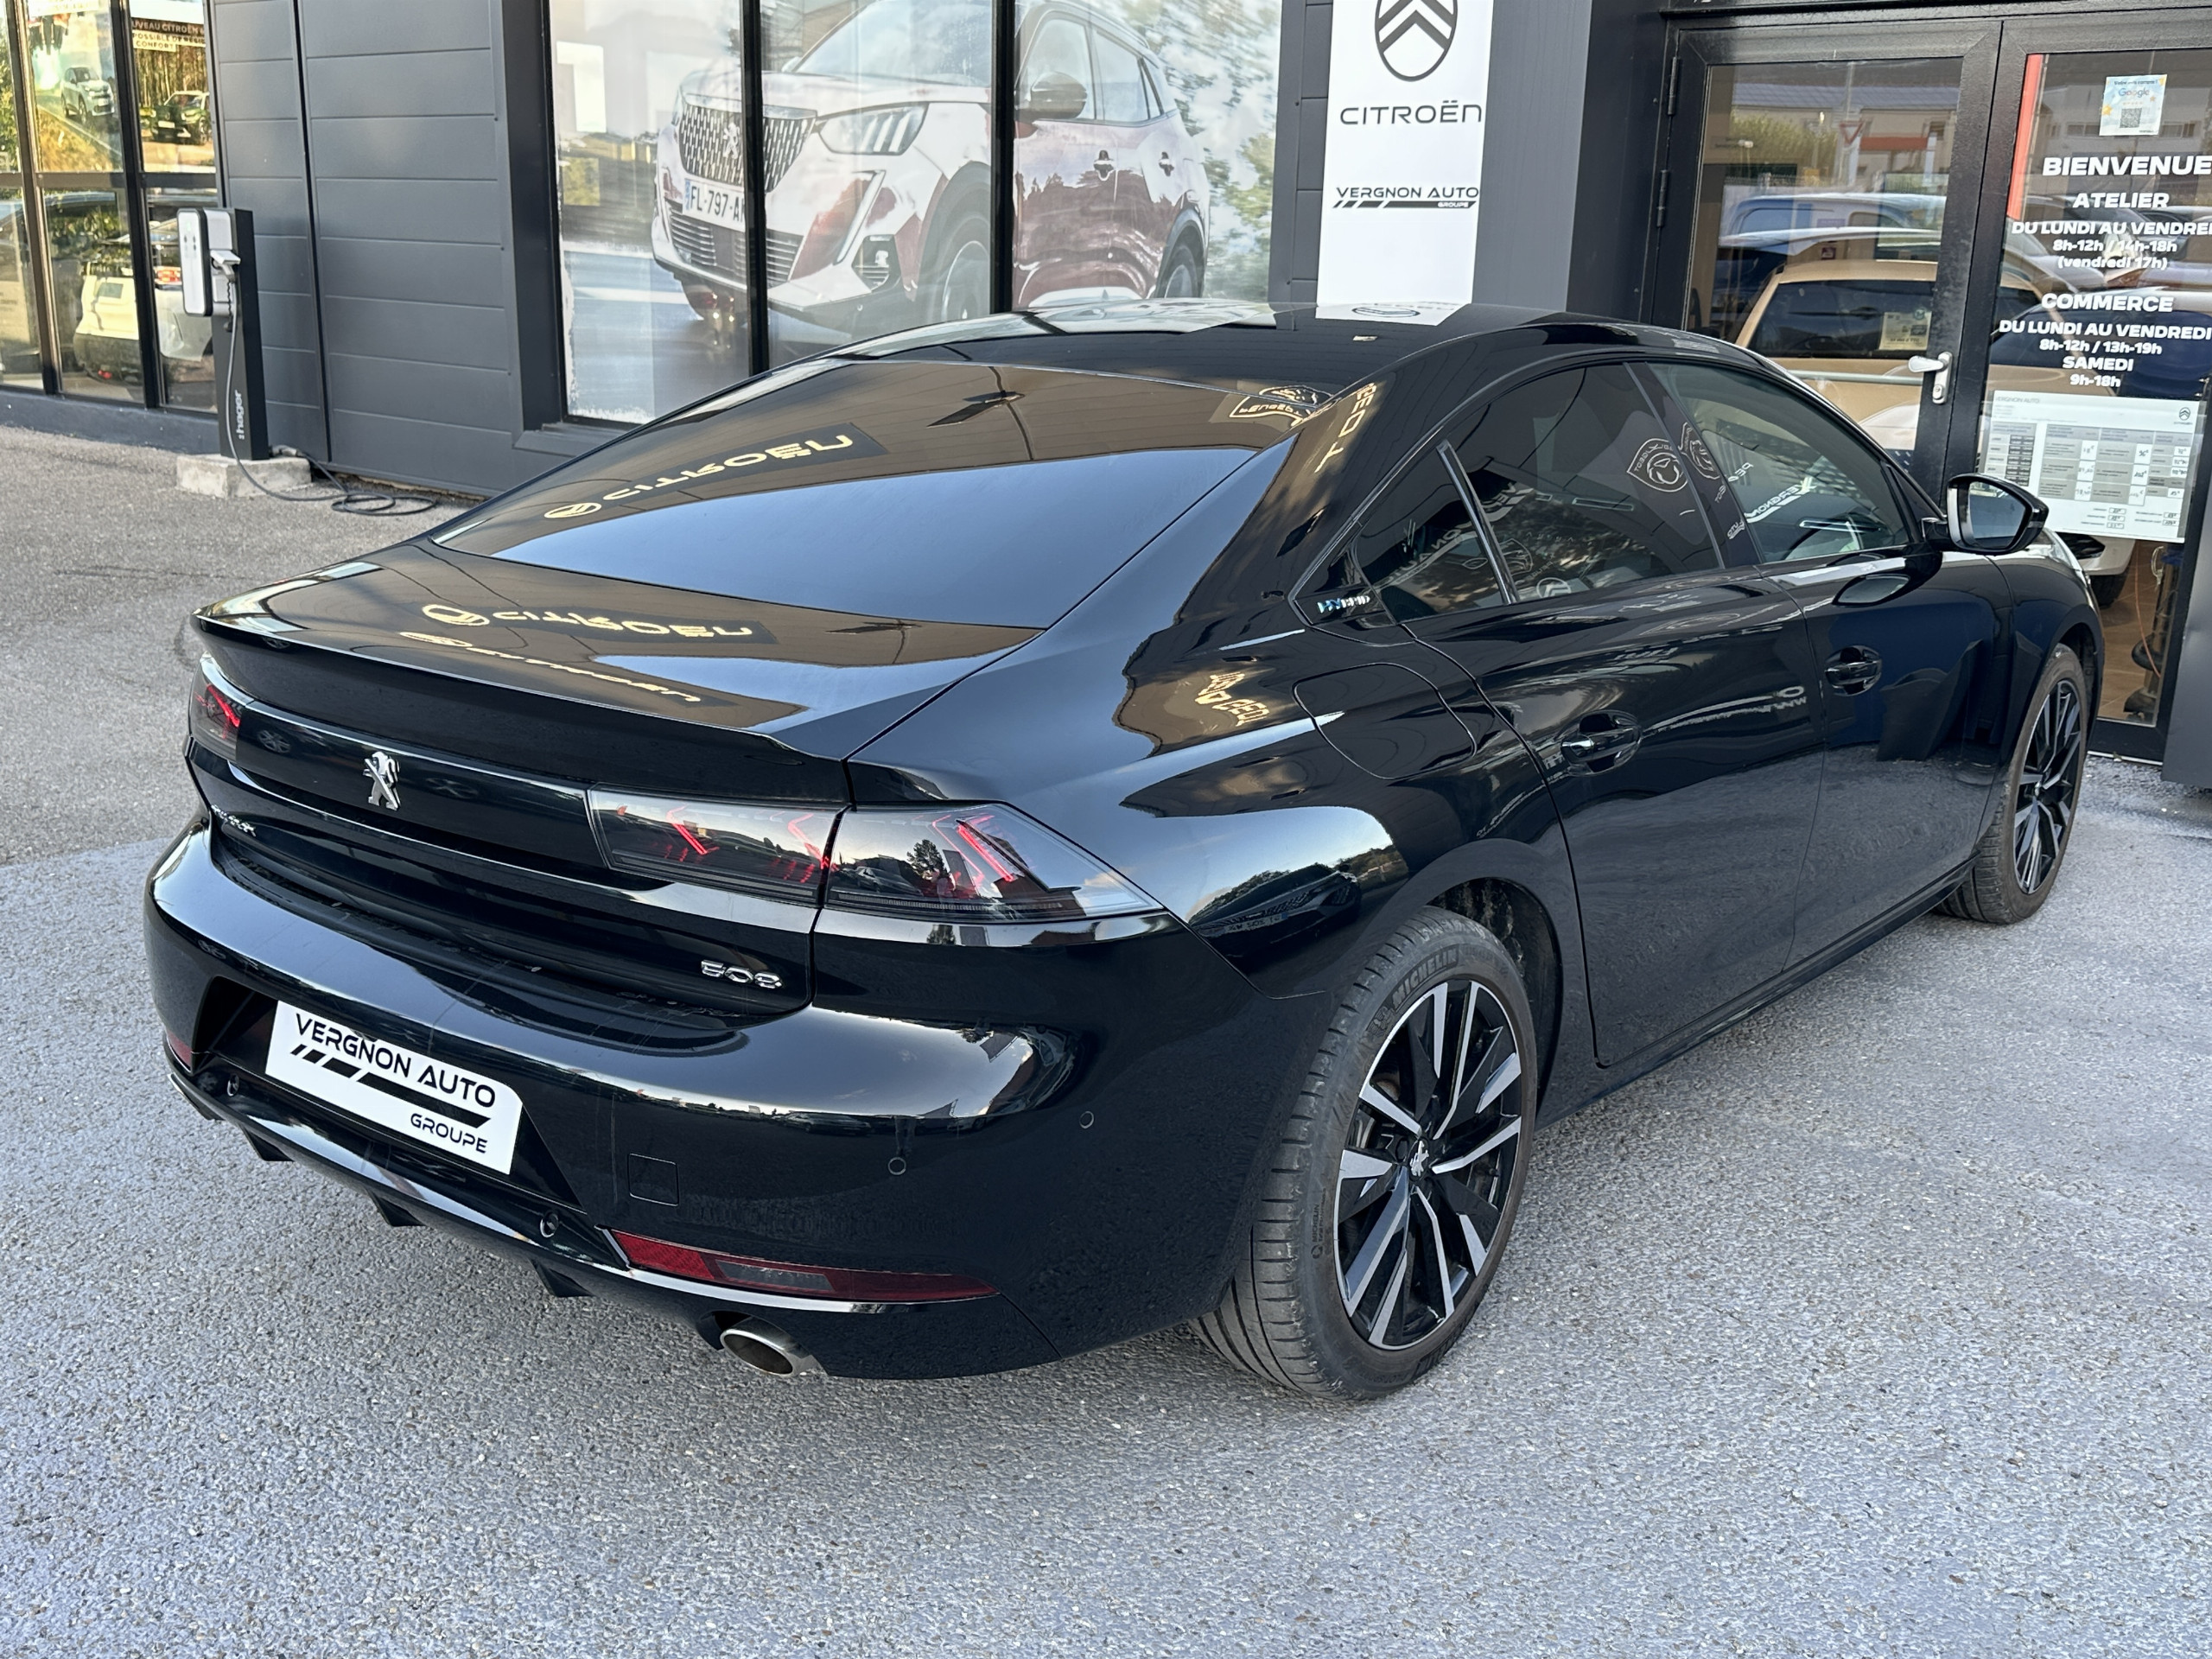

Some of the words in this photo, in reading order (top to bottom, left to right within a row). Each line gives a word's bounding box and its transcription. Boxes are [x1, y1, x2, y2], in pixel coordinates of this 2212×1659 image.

[2119, 87, 2150, 98] Google
[1340, 100, 1482, 124] CITROËN
[2042, 156, 2212, 176] BIENVENUE
[1336, 187, 1421, 198] VERGNON
[1427, 187, 1479, 198] AUTO
[2073, 193, 2170, 208] ATELIER
[2012, 221, 2038, 234] DU
[2040, 221, 2095, 235] LUNDI
[2098, 222, 2126, 235] AU
[2053, 239, 2104, 251] 8h-12h
[2120, 240, 2177, 252] 14h-18h
[2058, 256, 2132, 269] (vendredi
[2136, 257, 2168, 270] 17h)
[2041, 293, 2175, 313] COMMERCE
[1999, 320, 2025, 334] DU
[2027, 321, 2082, 335] LUNDI
[2084, 323, 2113, 337] AU
[2115, 325, 2212, 340] VENDREDI
[2039, 339, 2090, 353] 8h-12h
[2102, 341, 2163, 355] 13h-19h
[2063, 356, 2134, 372] SAMEDI
[2070, 375, 2121, 388] 9h-18h
[234, 389, 245, 434] hager
[701, 959, 783, 989] 508
[1391, 948, 1459, 1009] MICHELIN
[295, 1013, 411, 1078] VERGNON
[416, 1065, 496, 1109] AUTO
[410, 1112, 488, 1154] GROUPE
